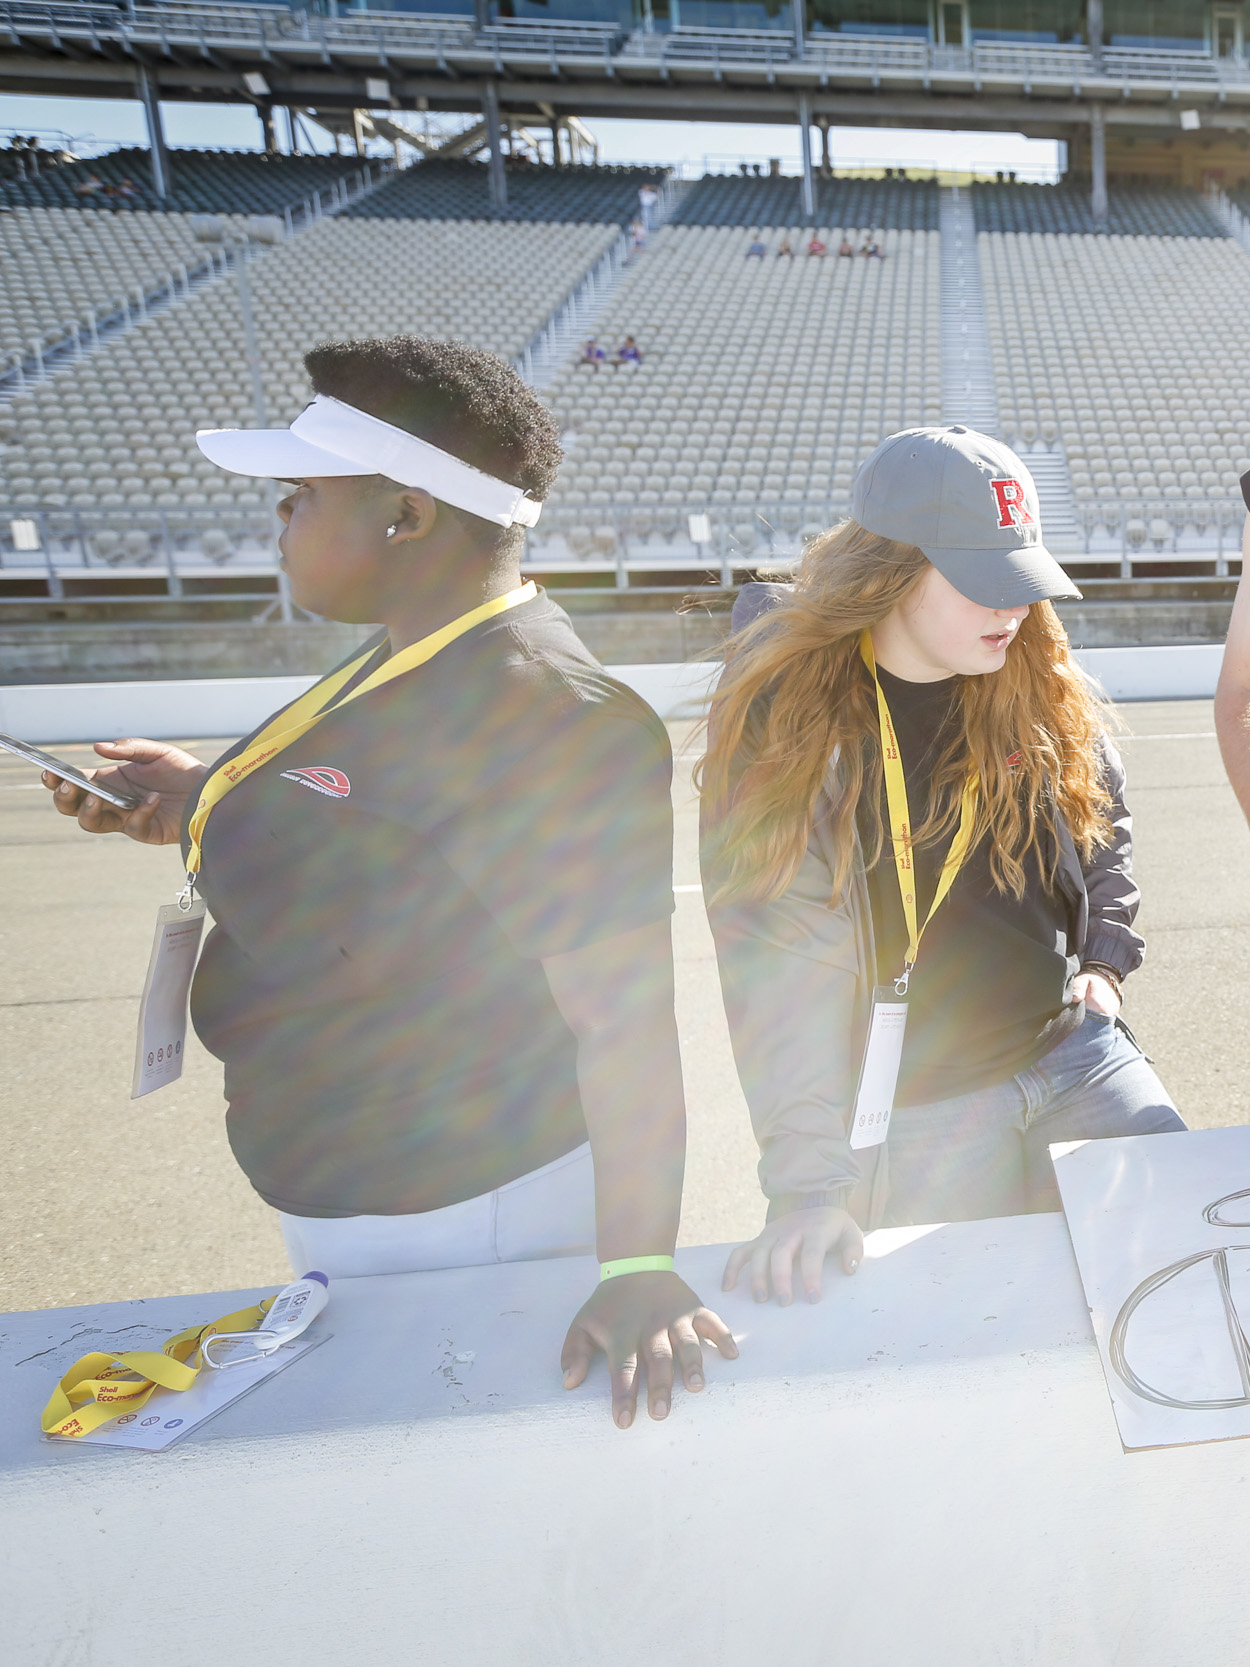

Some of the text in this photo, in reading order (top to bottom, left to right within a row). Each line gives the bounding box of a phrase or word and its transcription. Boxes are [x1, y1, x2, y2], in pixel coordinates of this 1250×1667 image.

[988, 478, 1037, 529] R
[886, 713, 898, 760] Eco-marathon
[223, 765, 237, 777] Shell
[228, 747, 279, 782] Eco-marathon
